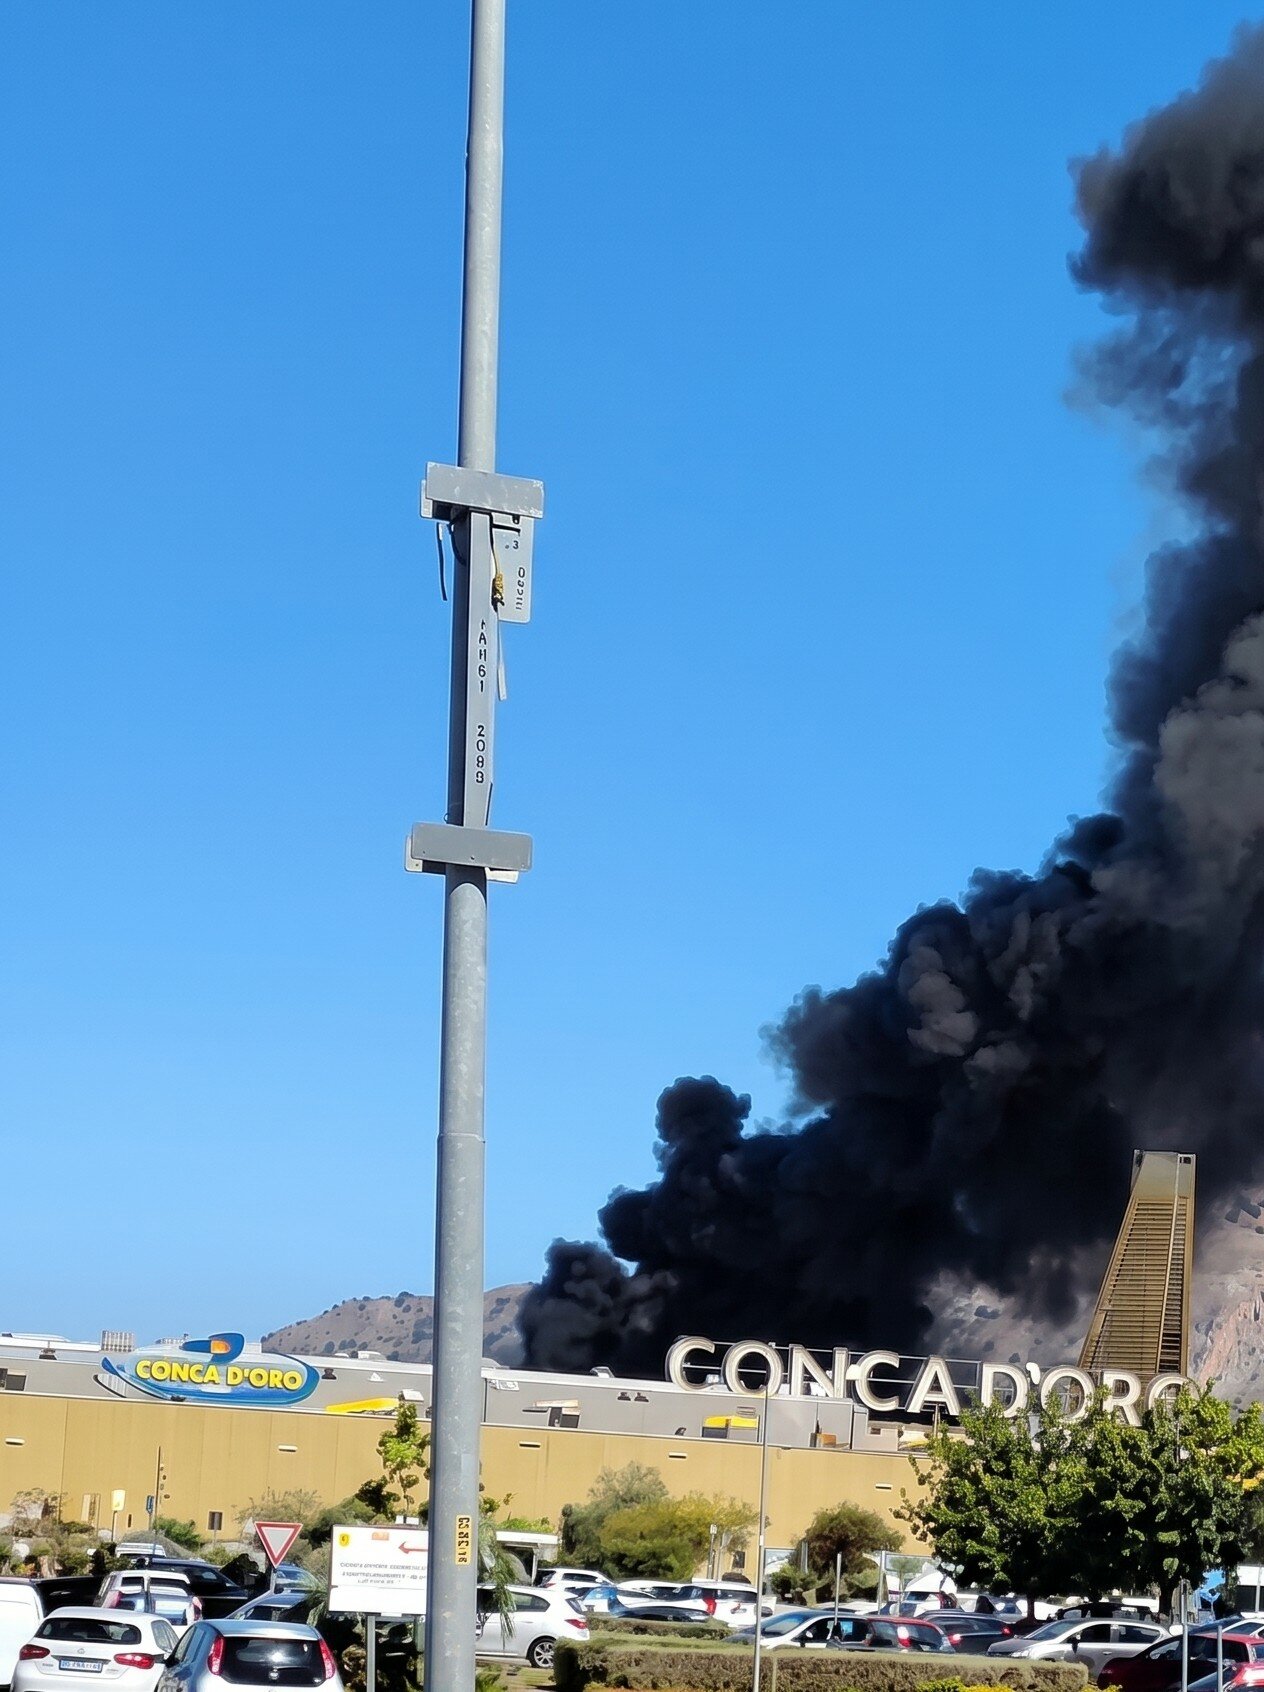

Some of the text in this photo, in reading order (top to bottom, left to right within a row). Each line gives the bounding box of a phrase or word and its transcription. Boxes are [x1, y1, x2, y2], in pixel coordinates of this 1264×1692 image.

[136, 1359, 303, 1391] CONCA D'ORO
[665, 1336, 960, 1416] CONCA
